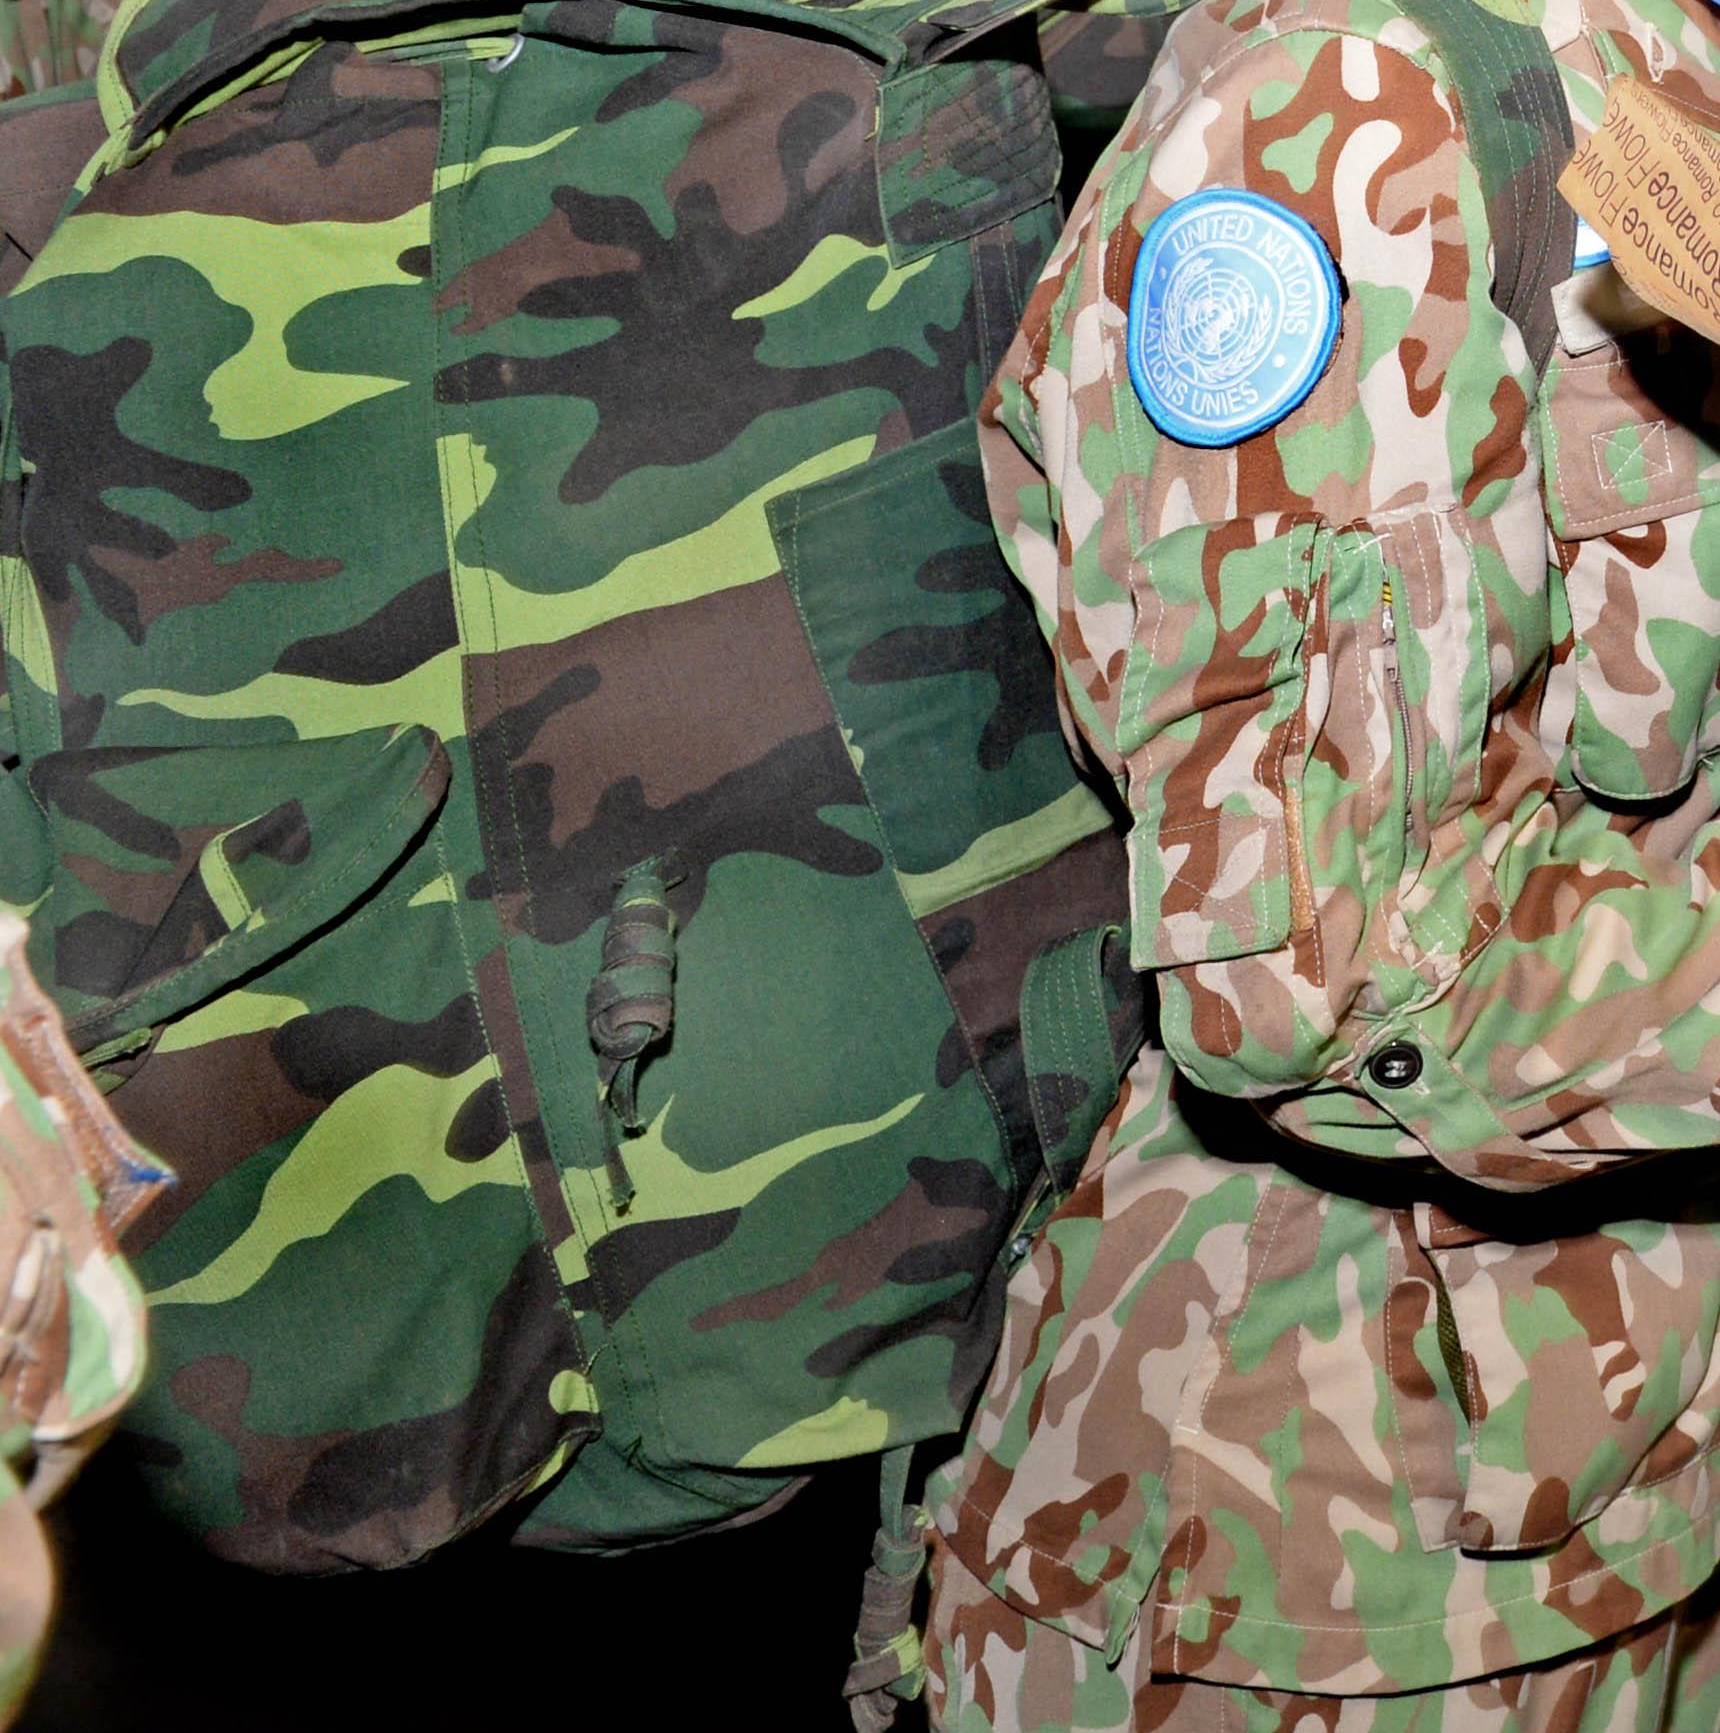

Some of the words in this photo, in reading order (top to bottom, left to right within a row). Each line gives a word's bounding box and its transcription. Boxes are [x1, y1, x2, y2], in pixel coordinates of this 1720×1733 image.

[1671, 132, 1719, 204] Romance
[1172, 214, 1253, 255] UNITED
[1256, 228, 1313, 335] NATIONS
[1143, 307, 1191, 407] NATIONS
[1190, 380, 1259, 416] UNIES
